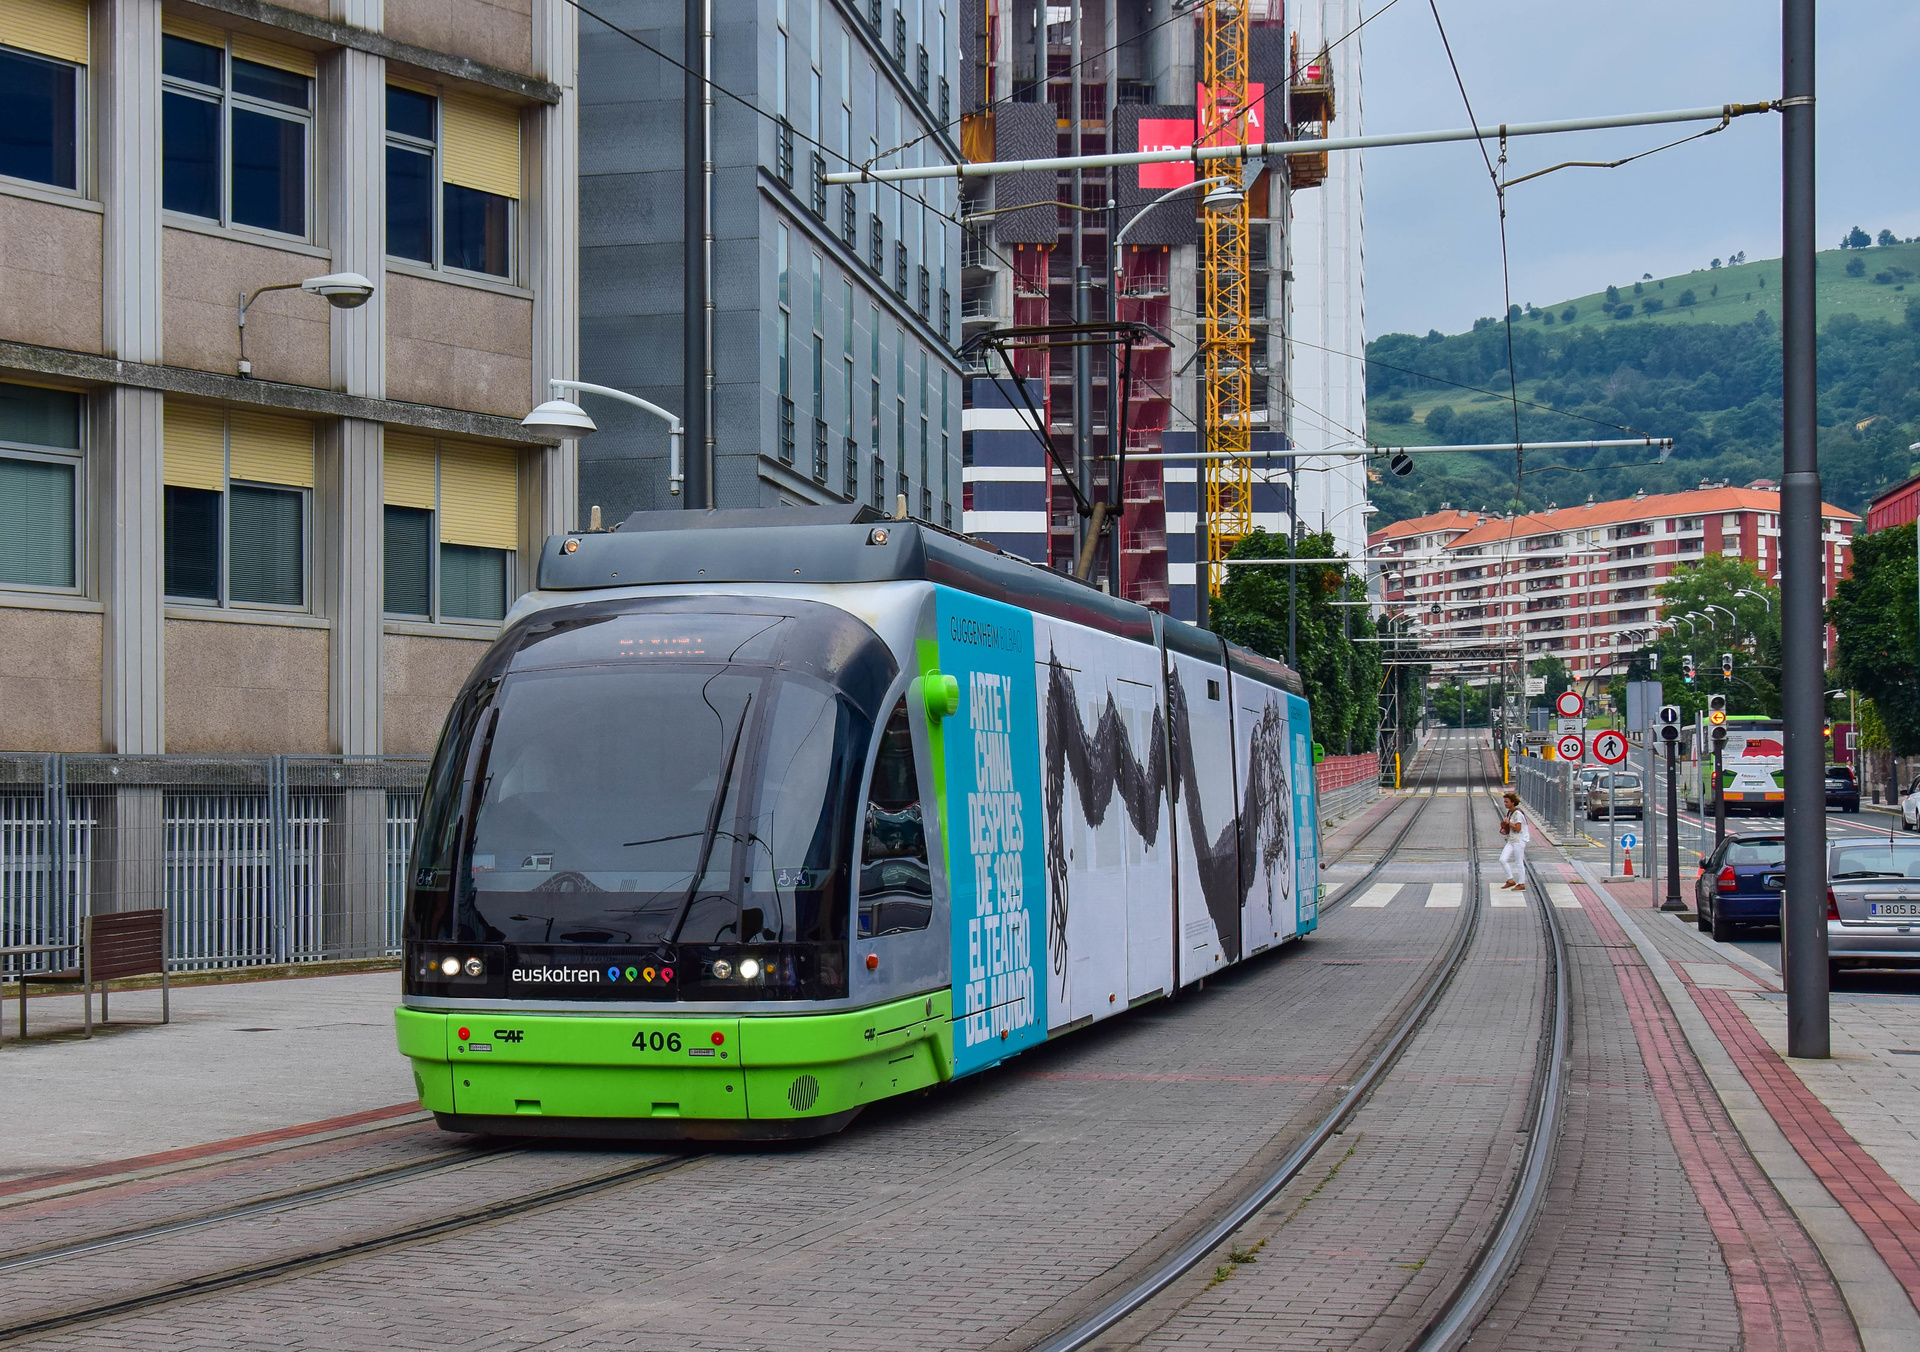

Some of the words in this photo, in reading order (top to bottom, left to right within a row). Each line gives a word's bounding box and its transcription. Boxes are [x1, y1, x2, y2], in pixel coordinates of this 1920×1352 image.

[950, 616, 999, 649] GUGGENHEIM
[1000, 626, 1023, 653] BILBAO
[969, 671, 1003, 732] ARTE
[1001, 675, 1011, 733] Y
[974, 729, 1014, 793] CHINA
[1563, 743, 1579, 753] 30
[968, 791, 1024, 855] DESPUES
[974, 854, 993, 917] DE
[993, 852, 1024, 914] 1989
[1879, 904, 1907, 915] 1805
[968, 918, 985, 983] EL
[984, 907, 1031, 978] TEATRO
[512, 965, 600, 983] euskotren
[965, 979, 990, 1048] DEL
[991, 965, 1035, 1038] MUNDO
[493, 1029, 524, 1043] CAF
[631, 1031, 682, 1053] 406
